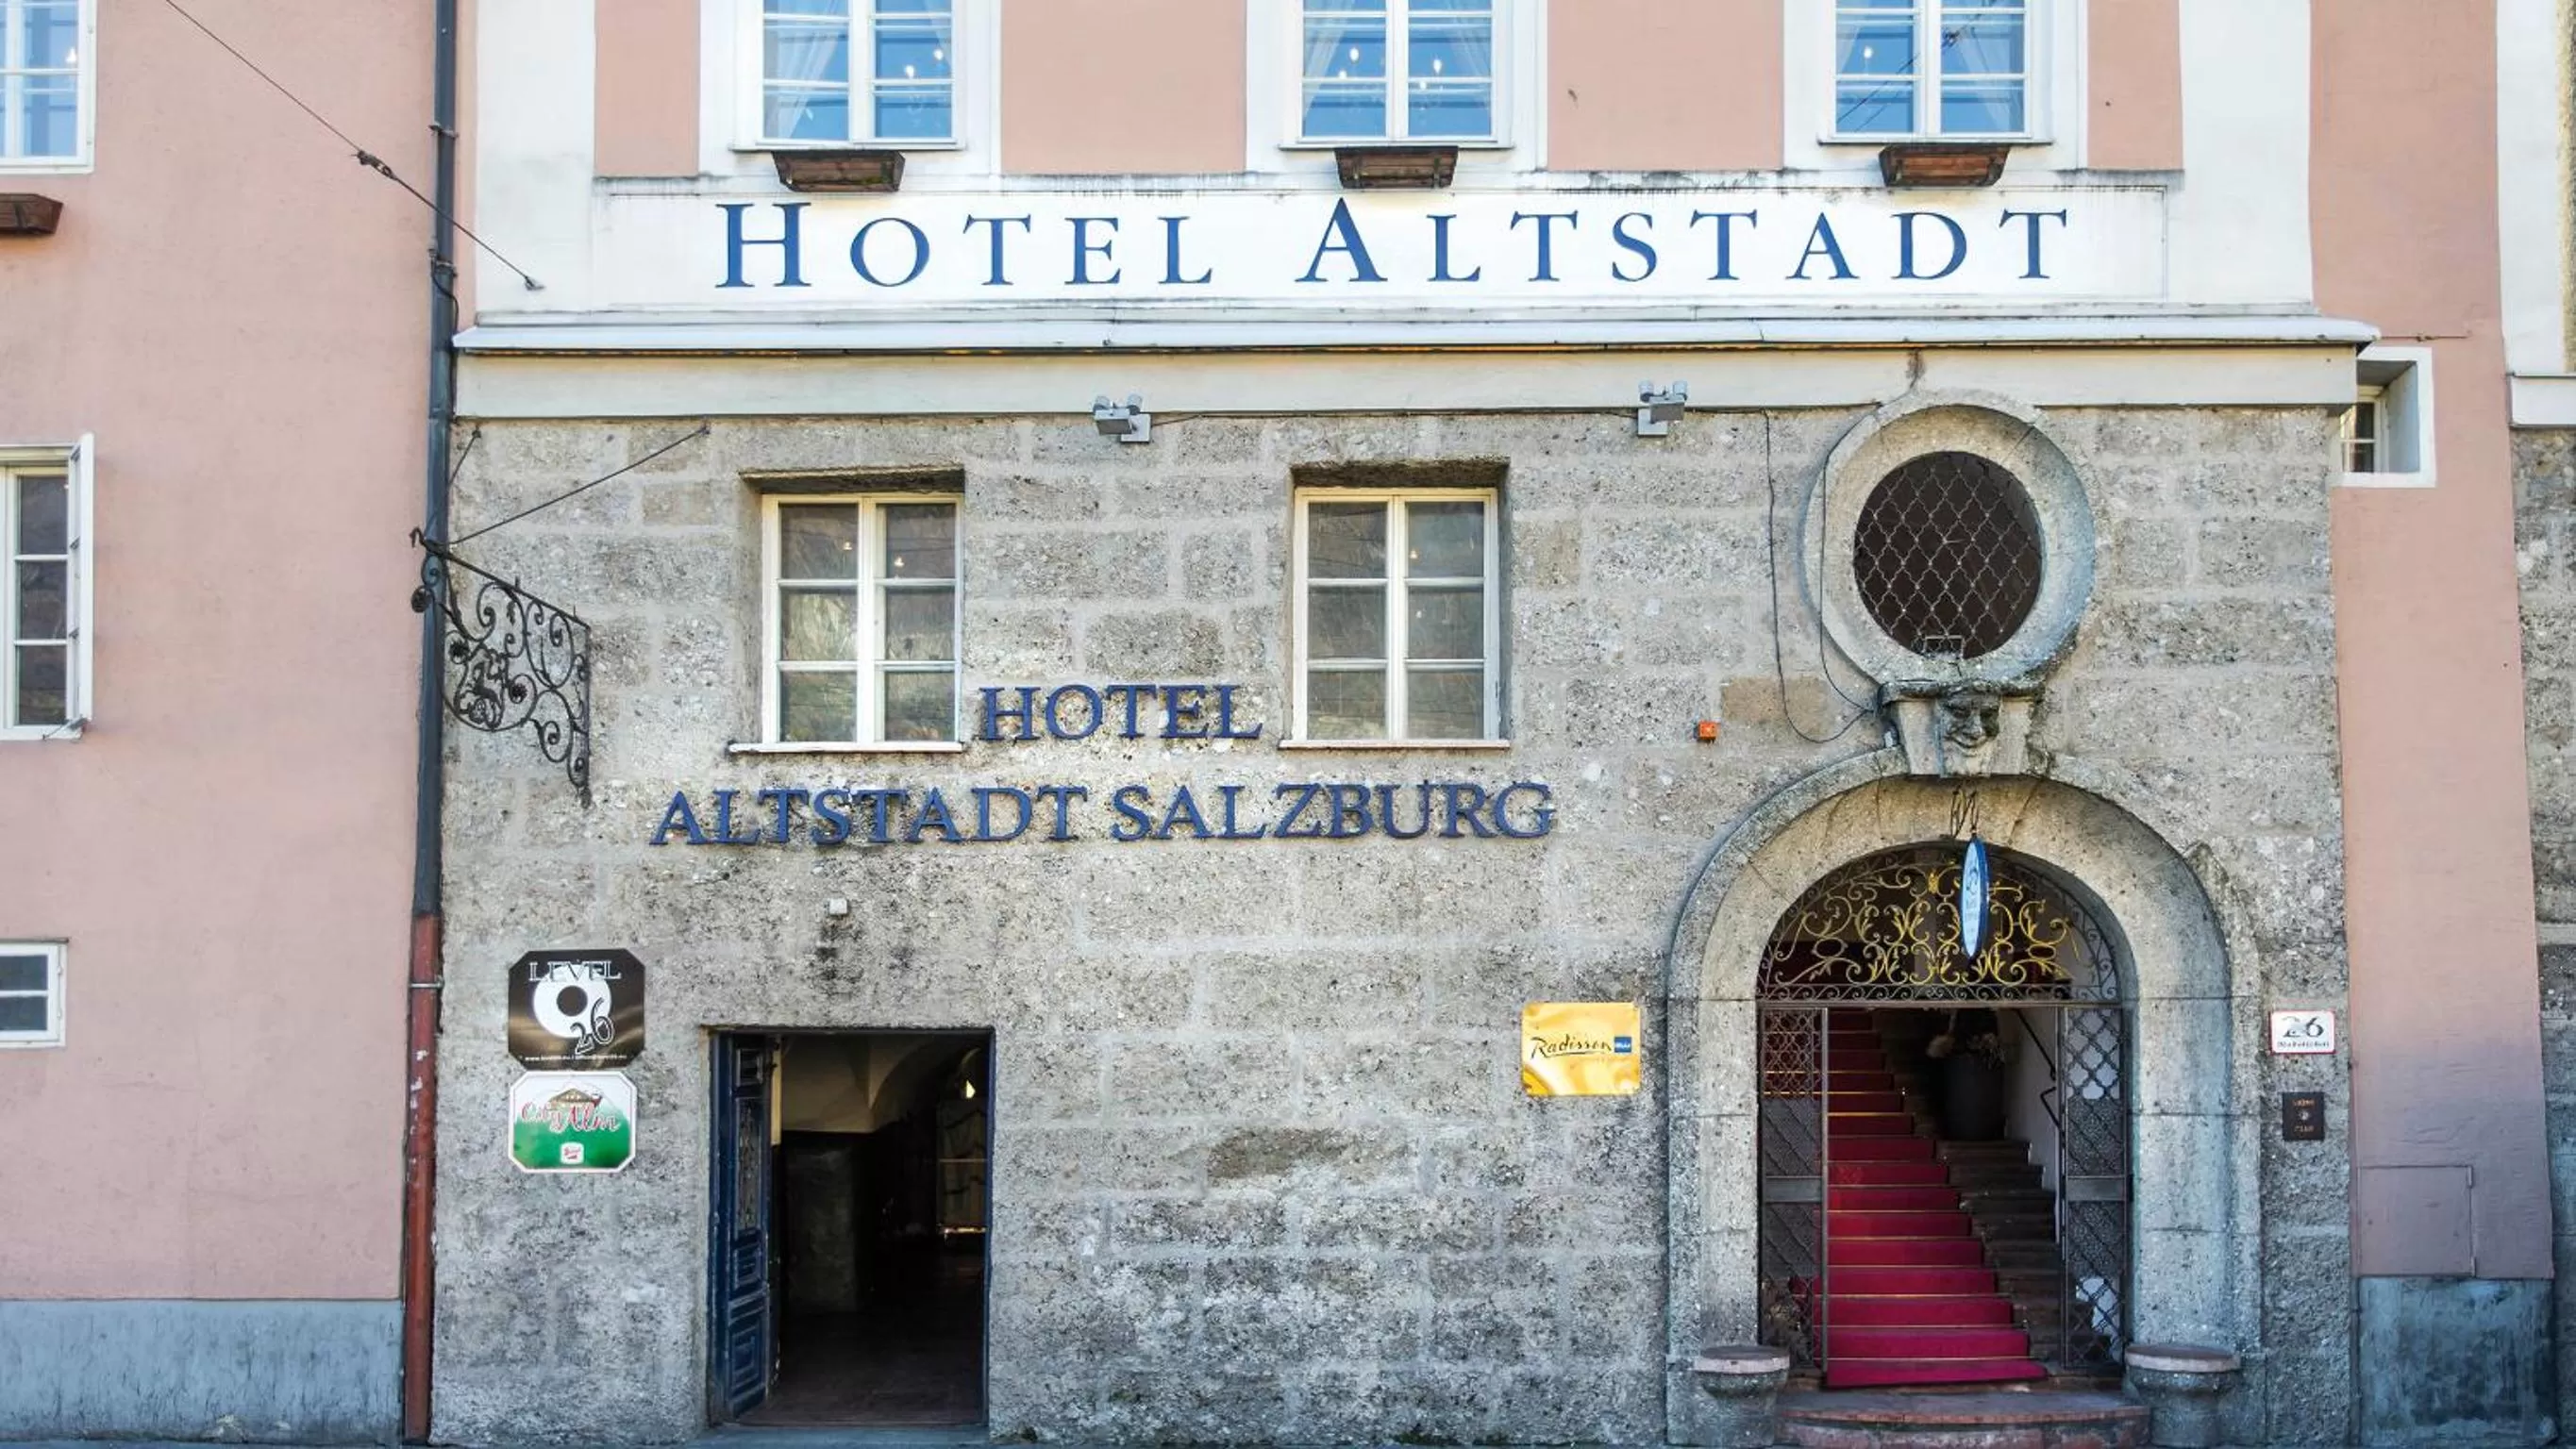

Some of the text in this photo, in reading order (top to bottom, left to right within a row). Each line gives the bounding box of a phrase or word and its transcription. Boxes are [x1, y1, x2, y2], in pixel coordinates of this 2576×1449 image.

[714, 196, 2068, 288] HOTEL ALTSTADT
[979, 684, 1263, 741] HOTEL
[649, 781, 1555, 846] ALTSTADT SALZBURG
[528, 960, 622, 983] LEVEL
[570, 996, 615, 1055] 26
[1530, 1033, 1613, 1059] Radisson
[2281, 1015, 2325, 1039] 26
